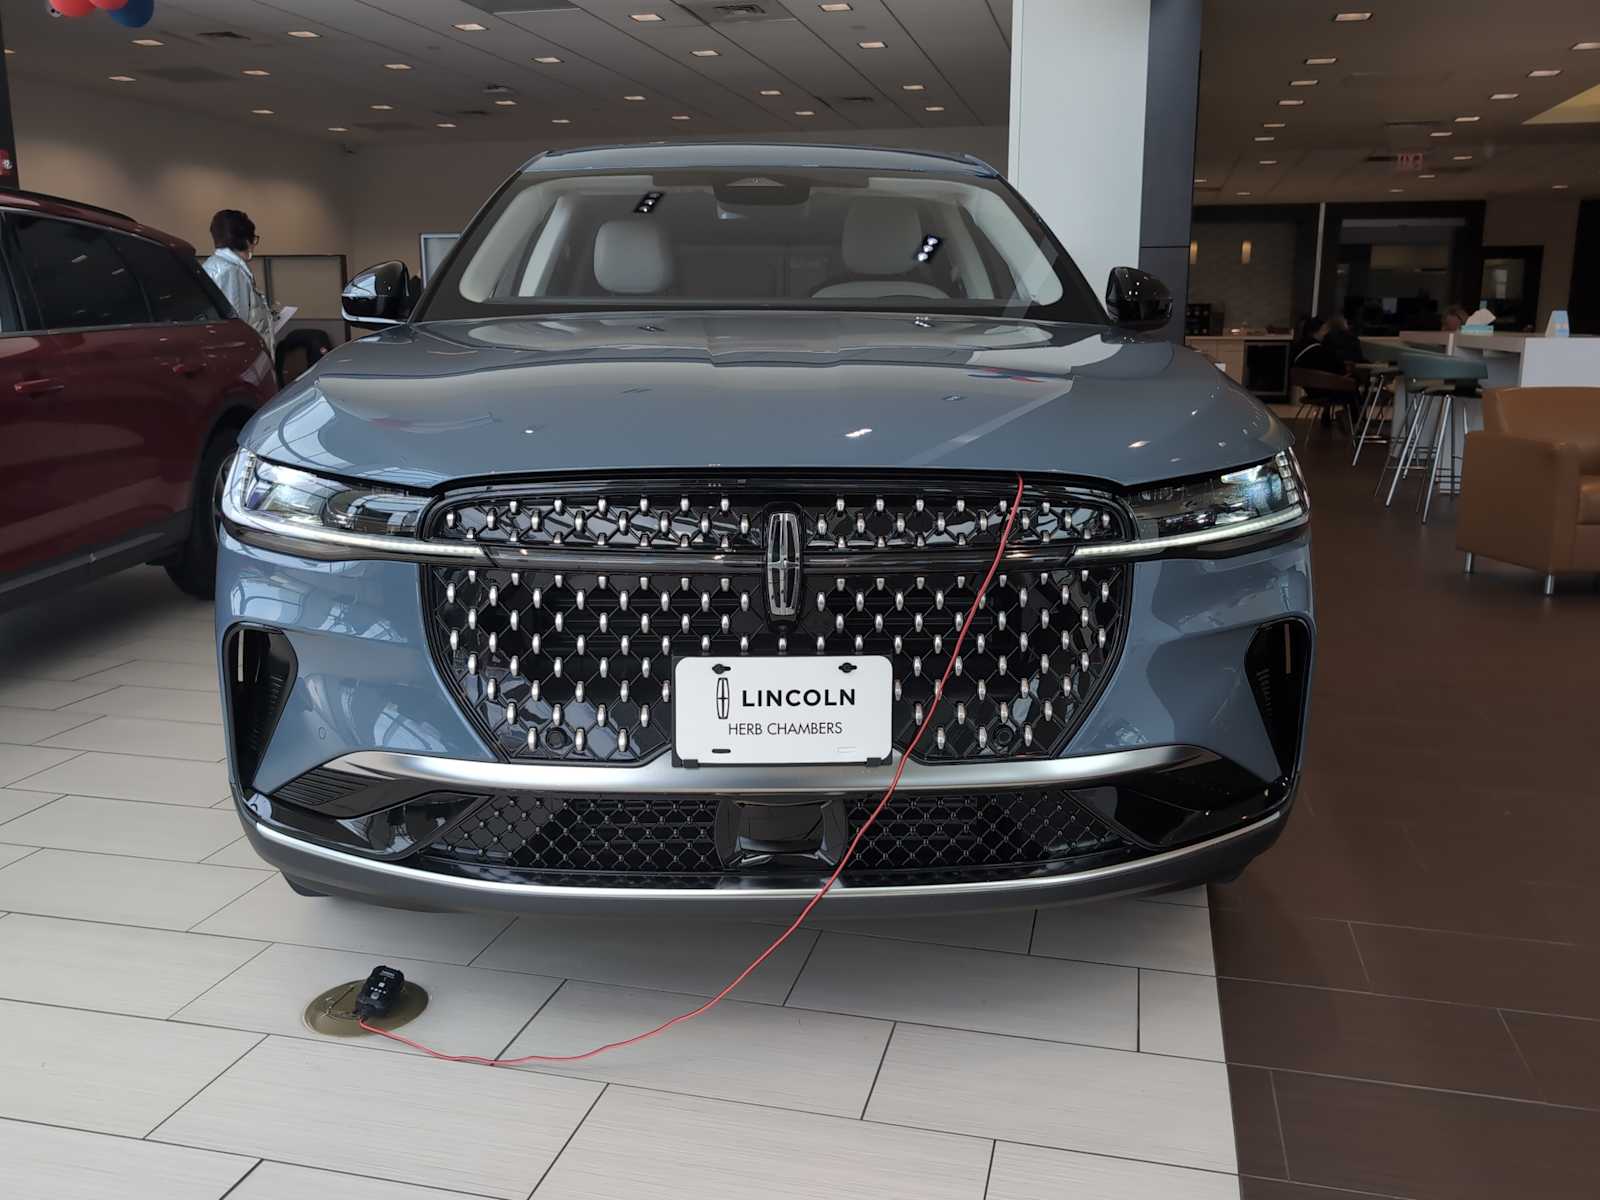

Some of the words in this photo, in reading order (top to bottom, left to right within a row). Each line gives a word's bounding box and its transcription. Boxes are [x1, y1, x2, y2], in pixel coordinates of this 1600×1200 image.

[742, 689, 856, 707] LINCOLN
[728, 723, 762, 736] HERB
[767, 722, 843, 735] CHAMBERS
